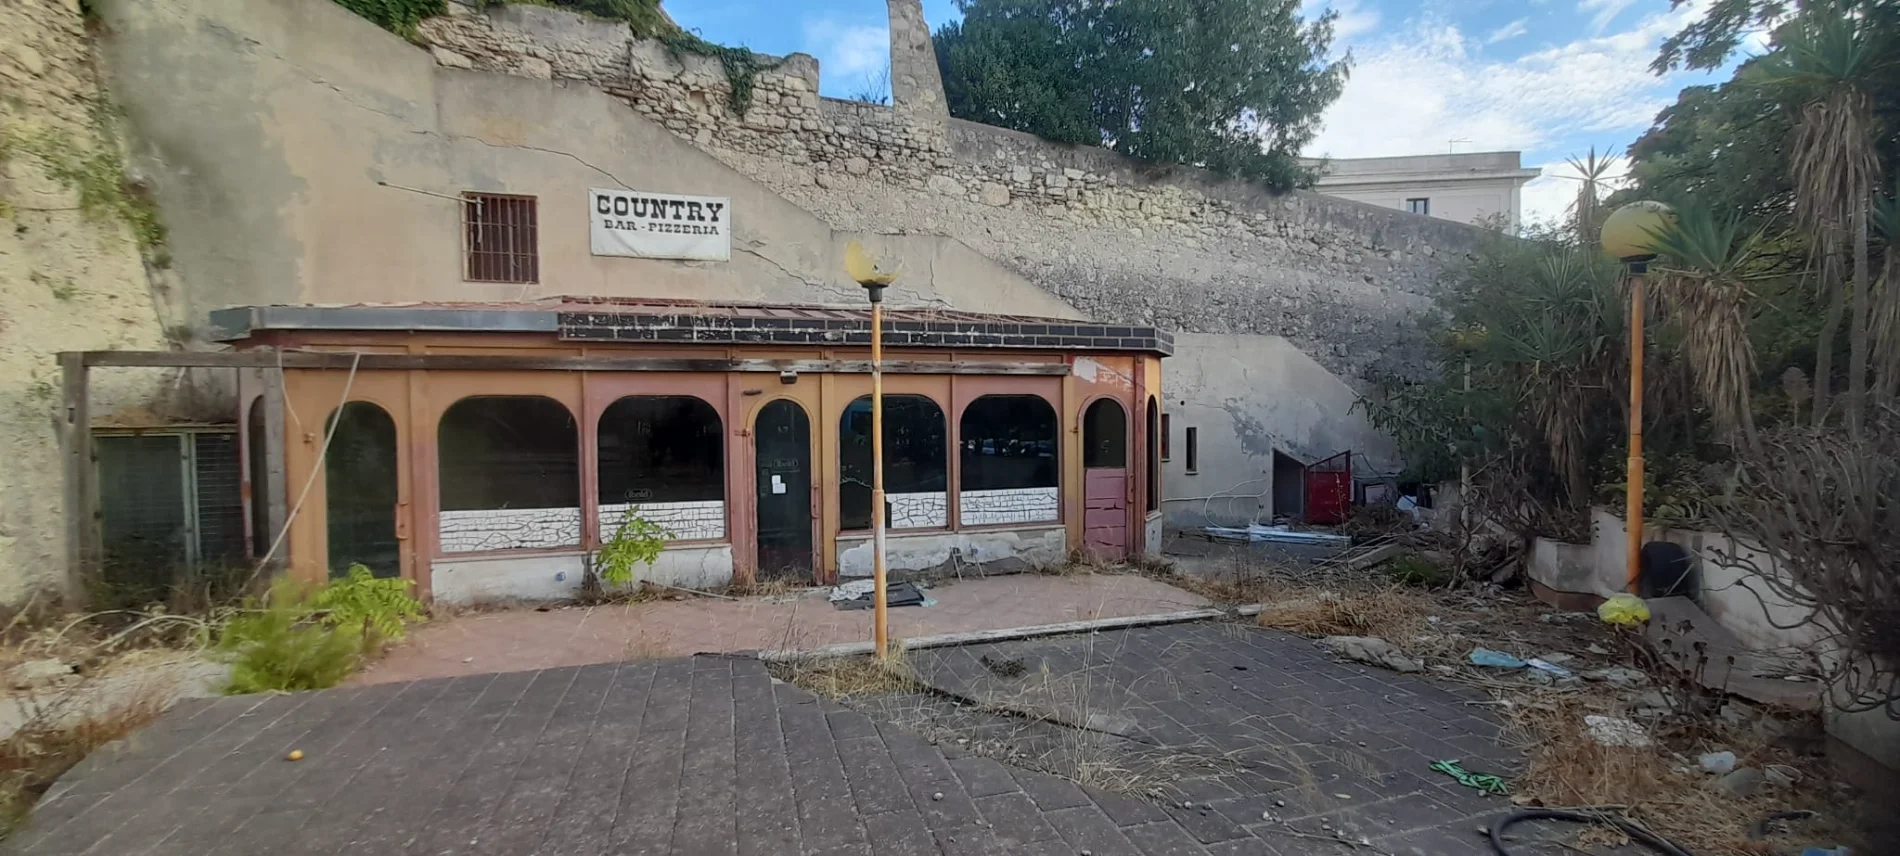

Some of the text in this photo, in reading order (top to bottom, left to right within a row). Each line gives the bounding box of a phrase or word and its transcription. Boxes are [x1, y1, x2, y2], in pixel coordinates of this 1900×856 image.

[597, 194, 723, 222] COUNTRY
[604, 219, 637, 231] BAR
[648, 222, 720, 236] PIZZERIA
